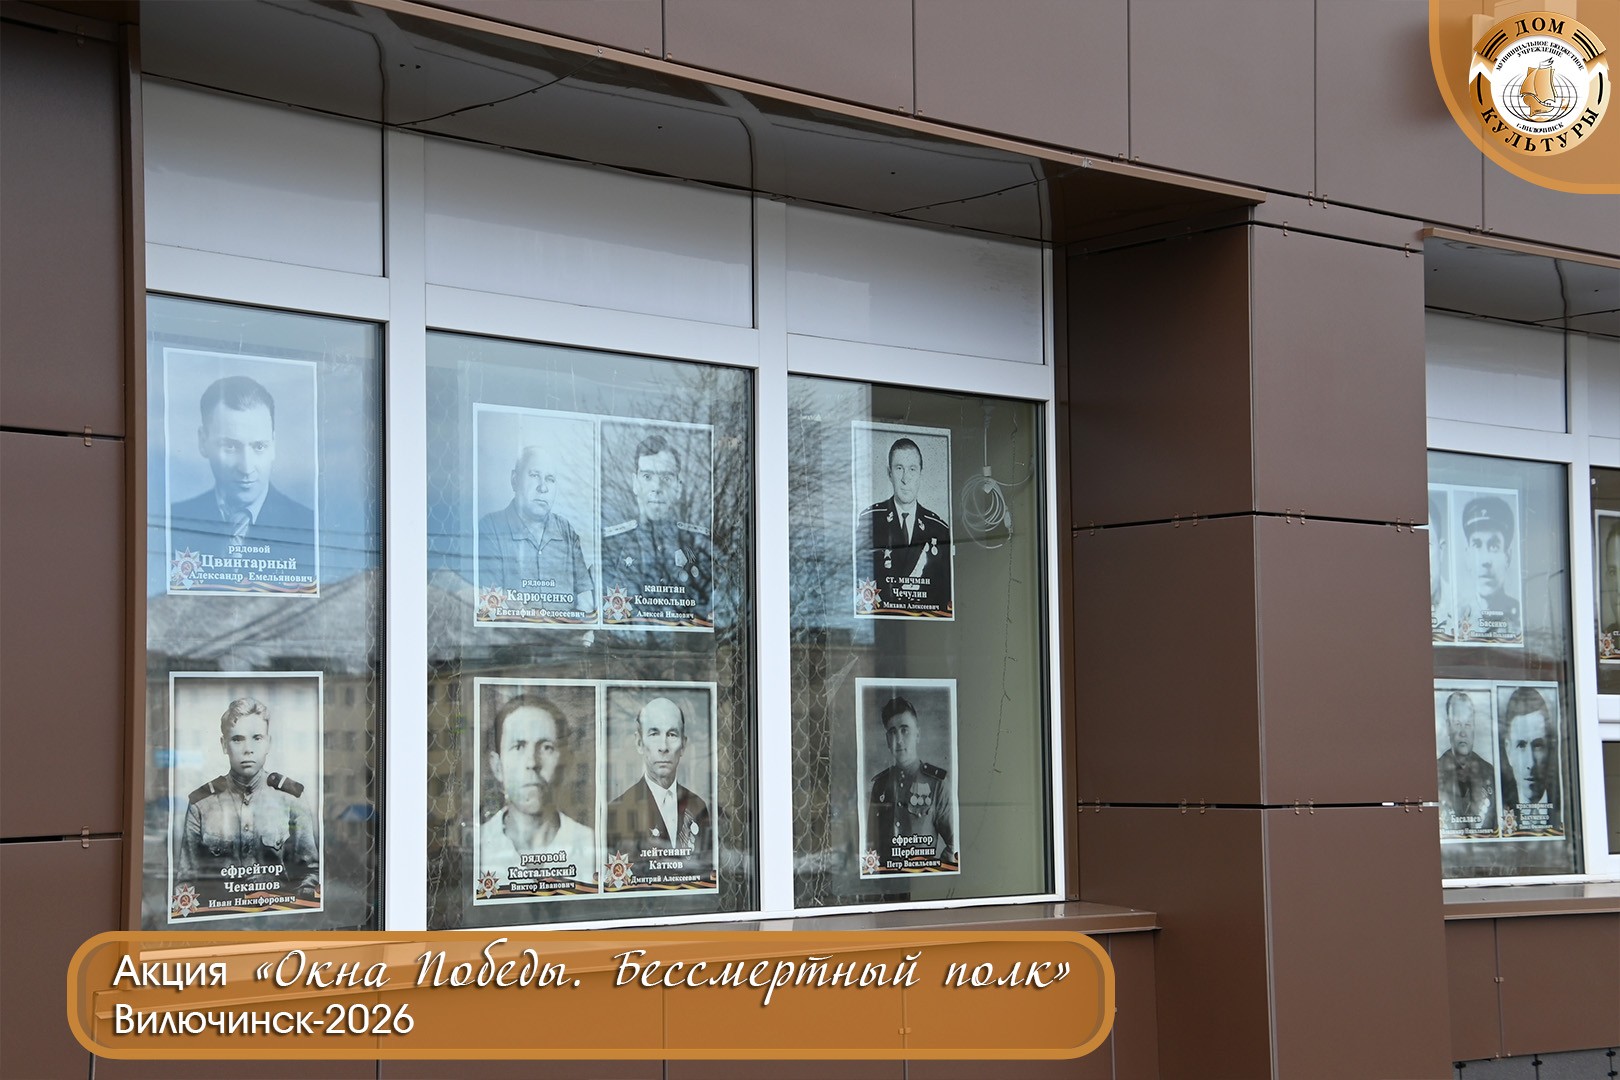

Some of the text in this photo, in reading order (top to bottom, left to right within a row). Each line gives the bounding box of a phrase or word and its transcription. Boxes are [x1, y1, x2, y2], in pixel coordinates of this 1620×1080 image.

[228, 545, 271, 554] рядовой
[201, 554, 297, 571] Цвинтарный
[189, 570, 313, 583] Александр Емельянович
[898, 577, 931, 585] мичман
[522, 579, 556, 587] рядовой
[644, 584, 685, 593] капитан
[507, 589, 574, 604] Карюченко
[892, 588, 927, 600] Чечулин
[634, 594, 696, 607] Колокольцов
[496, 607, 536, 617] Евстафий
[636, 610, 664, 618] Алексей
[891, 834, 933, 846] ефрейтор
[640, 847, 692, 857] лейтенант
[891, 847, 935, 858] Щербинин
[521, 851, 566, 865] рядовой
[649, 860, 684, 870] Катков
[886, 860, 941, 869] Петр Васильевич
[220, 864, 283, 878] ефрейтор
[508, 866, 576, 879] Кастальский
[631, 876, 662, 885] Дмитрий
[223, 881, 281, 893] Чекашов
[511, 882, 575, 891] Виктор Иванович
[208, 895, 296, 908] Иван Никифорович
